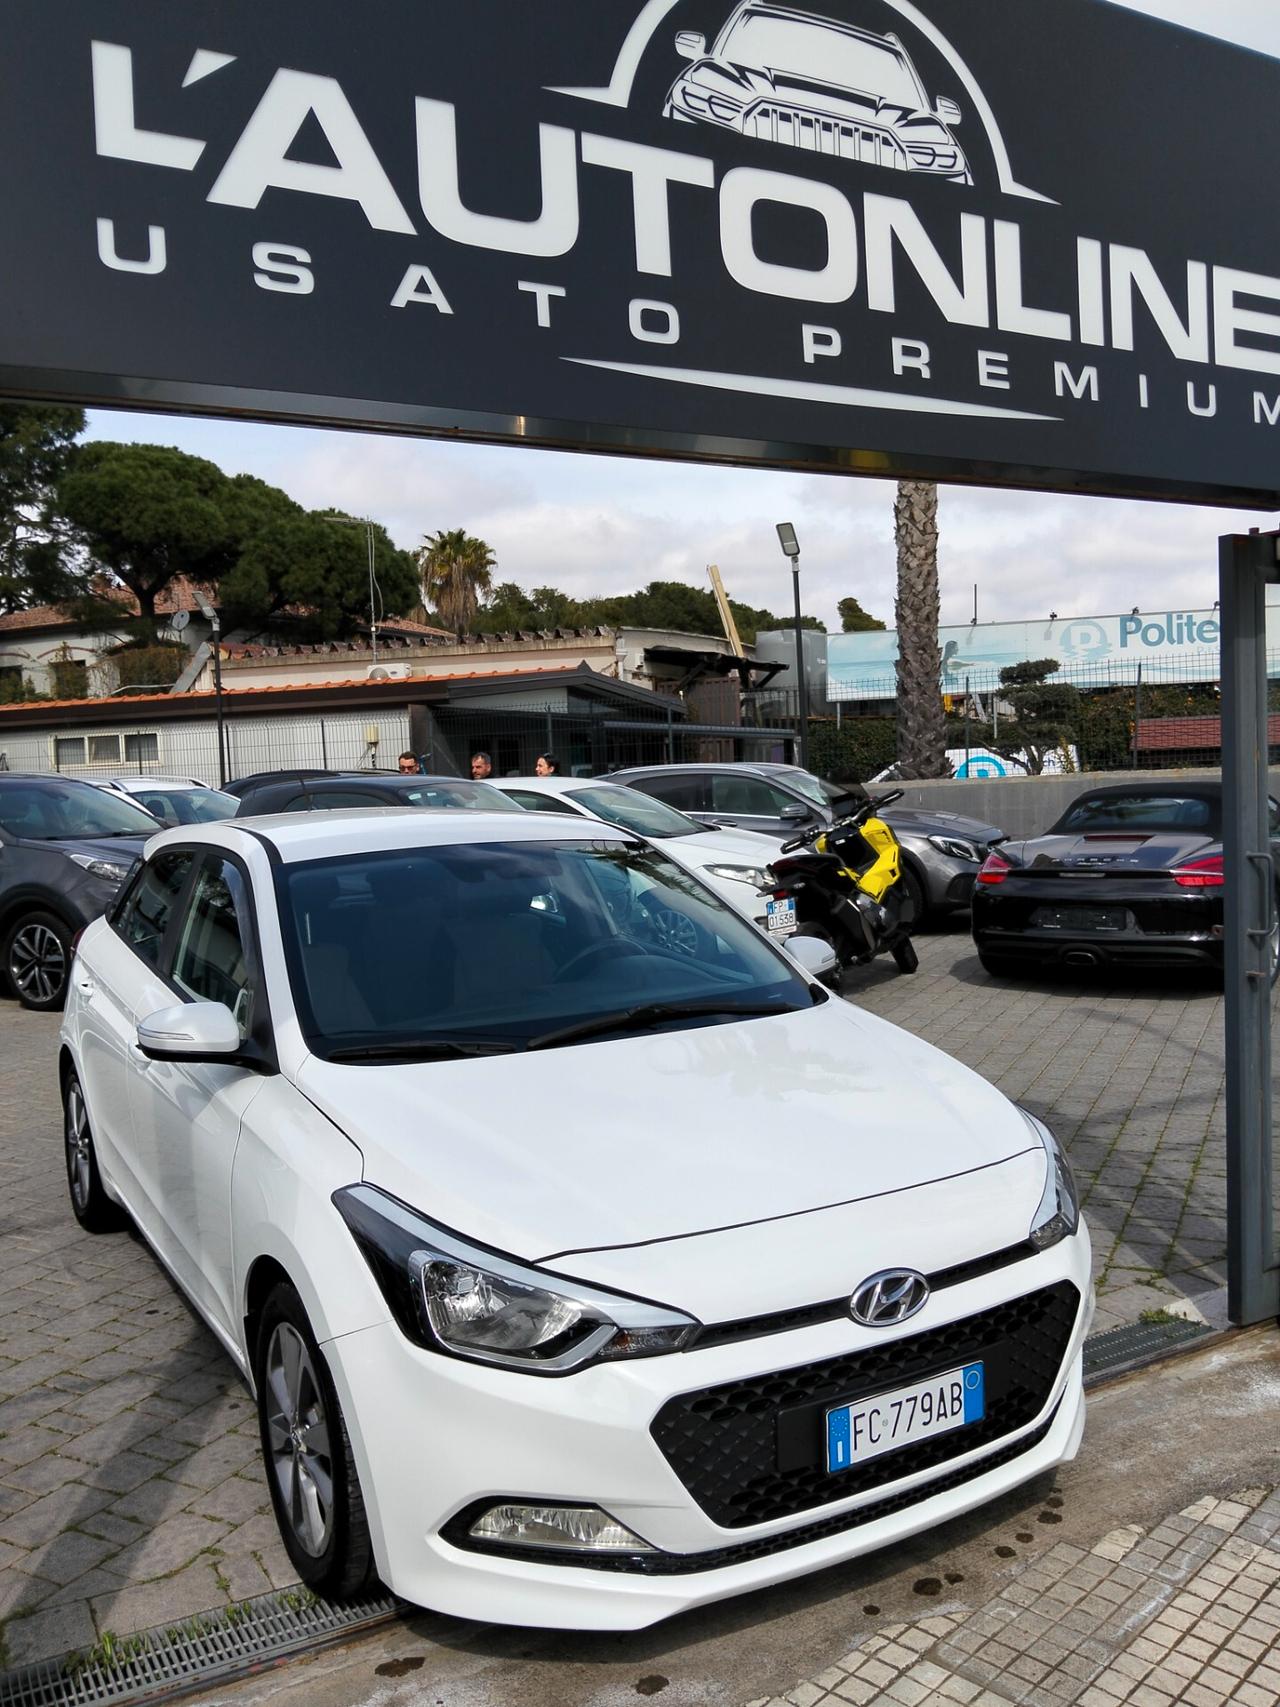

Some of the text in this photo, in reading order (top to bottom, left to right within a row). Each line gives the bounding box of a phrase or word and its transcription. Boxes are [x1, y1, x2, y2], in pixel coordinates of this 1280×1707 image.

[91, 40, 1280, 375] L'AUTONLINE
[96, 217, 1280, 425] USATO PREMIUM
